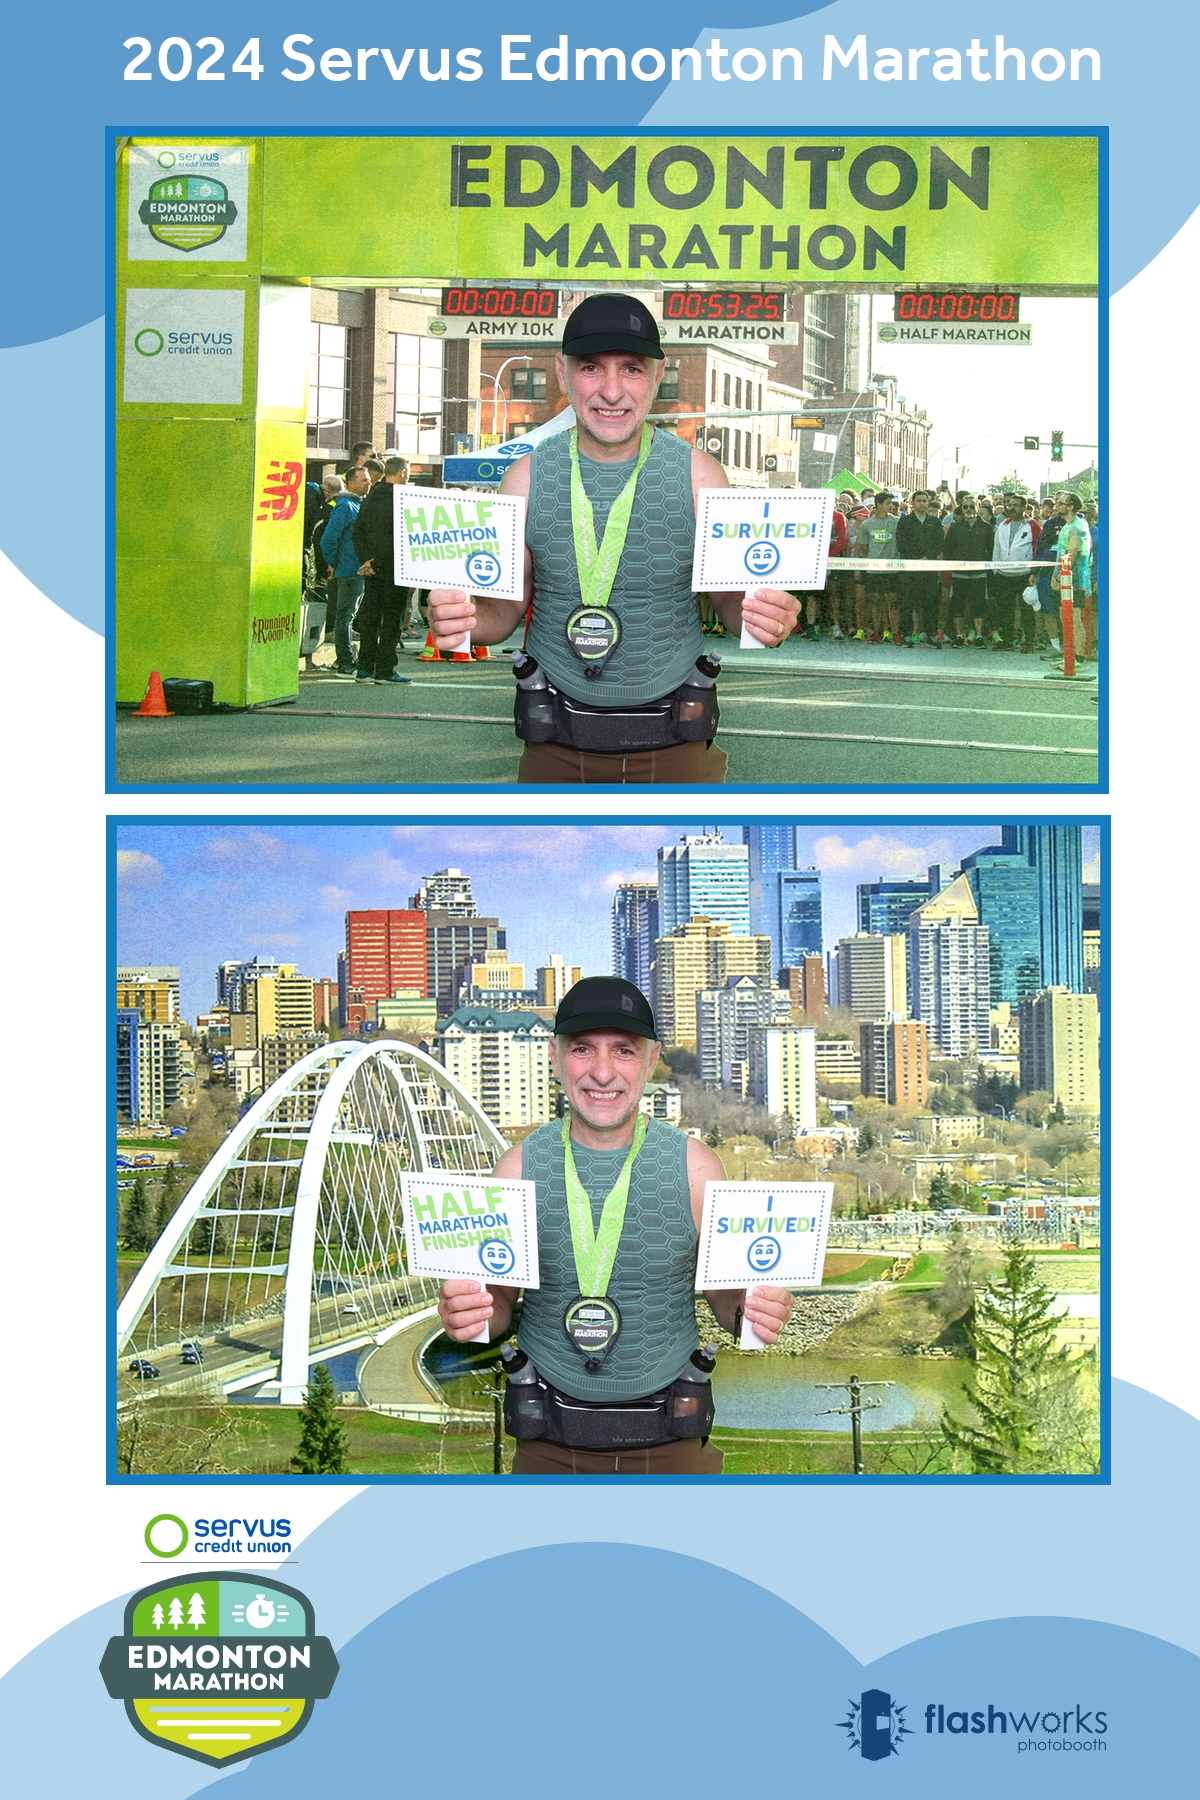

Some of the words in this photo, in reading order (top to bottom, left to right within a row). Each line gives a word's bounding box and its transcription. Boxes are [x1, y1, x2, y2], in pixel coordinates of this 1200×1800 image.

[178, 152, 220, 161] servus
[450, 145, 990, 211] EDMONTON
[149, 203, 227, 214] EDMONTON
[160, 214, 215, 222] MARATHON
[523, 223, 907, 271] MARATHON
[465, 321, 518, 336] ARMY
[521, 322, 554, 336] 10K
[678, 325, 785, 340] MARATHON
[900, 328, 939, 340] HALF
[942, 328, 1031, 341] MARATHON
[168, 332, 233, 345] servus
[168, 345, 200, 355] credit
[202, 347, 233, 355] union
[403, 501, 493, 533] HALF
[763, 502, 770, 518] I
[408, 526, 498, 546] MARATHON
[711, 522, 817, 539] SURVIVED!
[410, 541, 501, 563] FINISHER!
[257, 613, 291, 642] Running
[575, 639, 609, 647] MARATHON
[411, 1186, 503, 1222] HALF
[767, 1195, 774, 1212] I
[418, 1212, 509, 1235] MARATHON
[577, 1198, 586, 1235] MARATHON
[716, 1216, 816, 1234] SURVIVED!
[421, 1227, 514, 1252] FINISHER!
